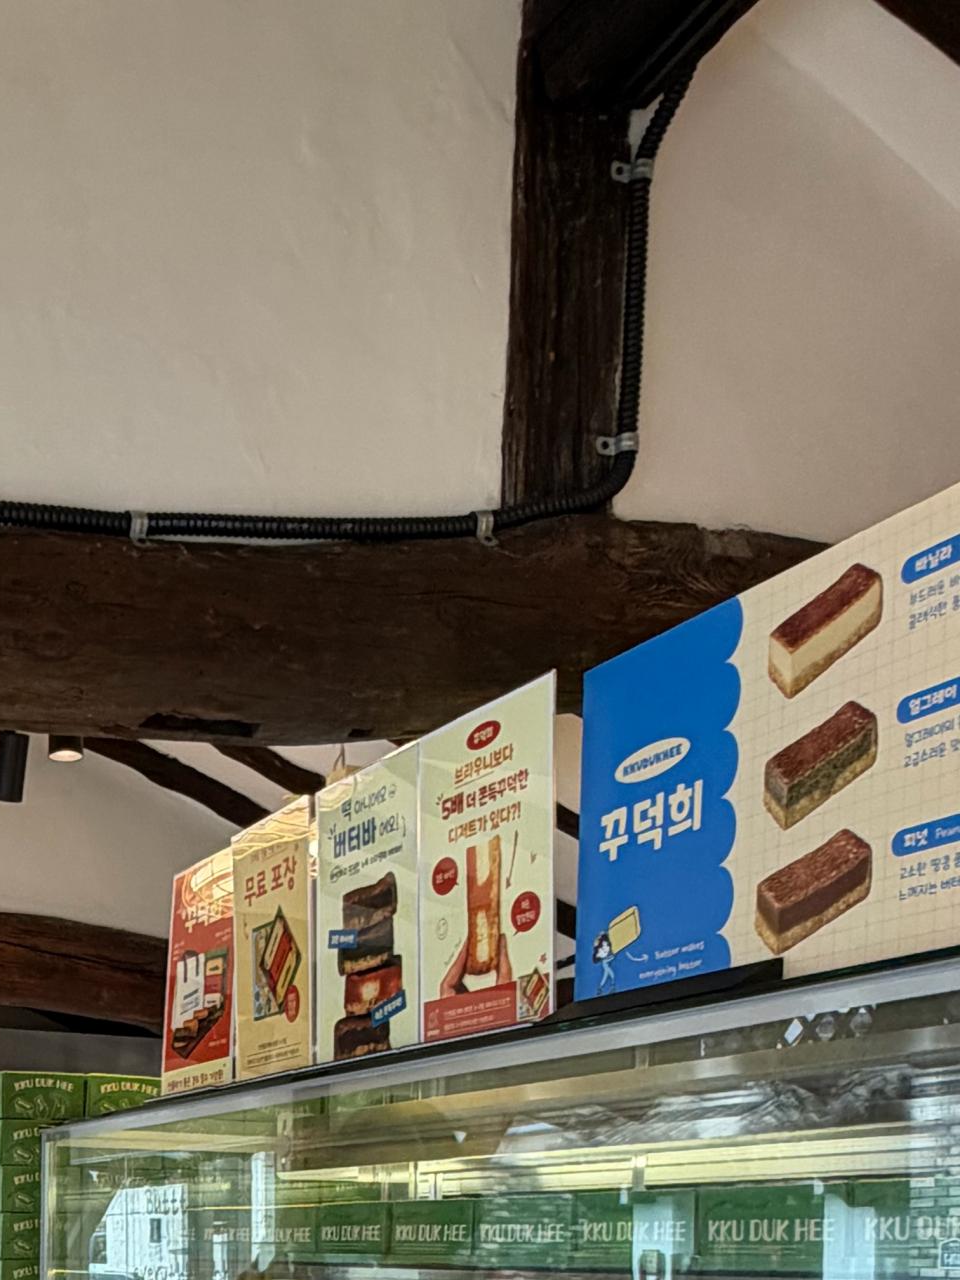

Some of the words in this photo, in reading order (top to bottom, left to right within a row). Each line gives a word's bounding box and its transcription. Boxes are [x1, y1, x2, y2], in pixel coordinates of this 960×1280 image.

[908, 684, 957, 715] 얼그레이
[454, 743, 514, 785] 브라우니보다
[599, 779, 704, 862] 꾸덕희
[334, 817, 377, 859] 버터바
[244, 870, 268, 907] 무료
[270, 855, 297, 891] 포장
[321, 1226, 339, 1241] KKU
[341, 1225, 361, 1241] DUK
[362, 1224, 381, 1241] HEE
[395, 1225, 417, 1241] KKU
[418, 1224, 441, 1241] DUK
[443, 1224, 467, 1242] HEE
[539, 1223, 565, 1243] HEE
[582, 1219, 613, 1241] KKU
[616, 1219, 649, 1241] DUK
[654, 1220, 686, 1242] HEE
[708, 1219, 744, 1241] KKU
[749, 1219, 789, 1241] DUK
[795, 1218, 836, 1242] HEE
[865, 1216, 910, 1241] KKU
